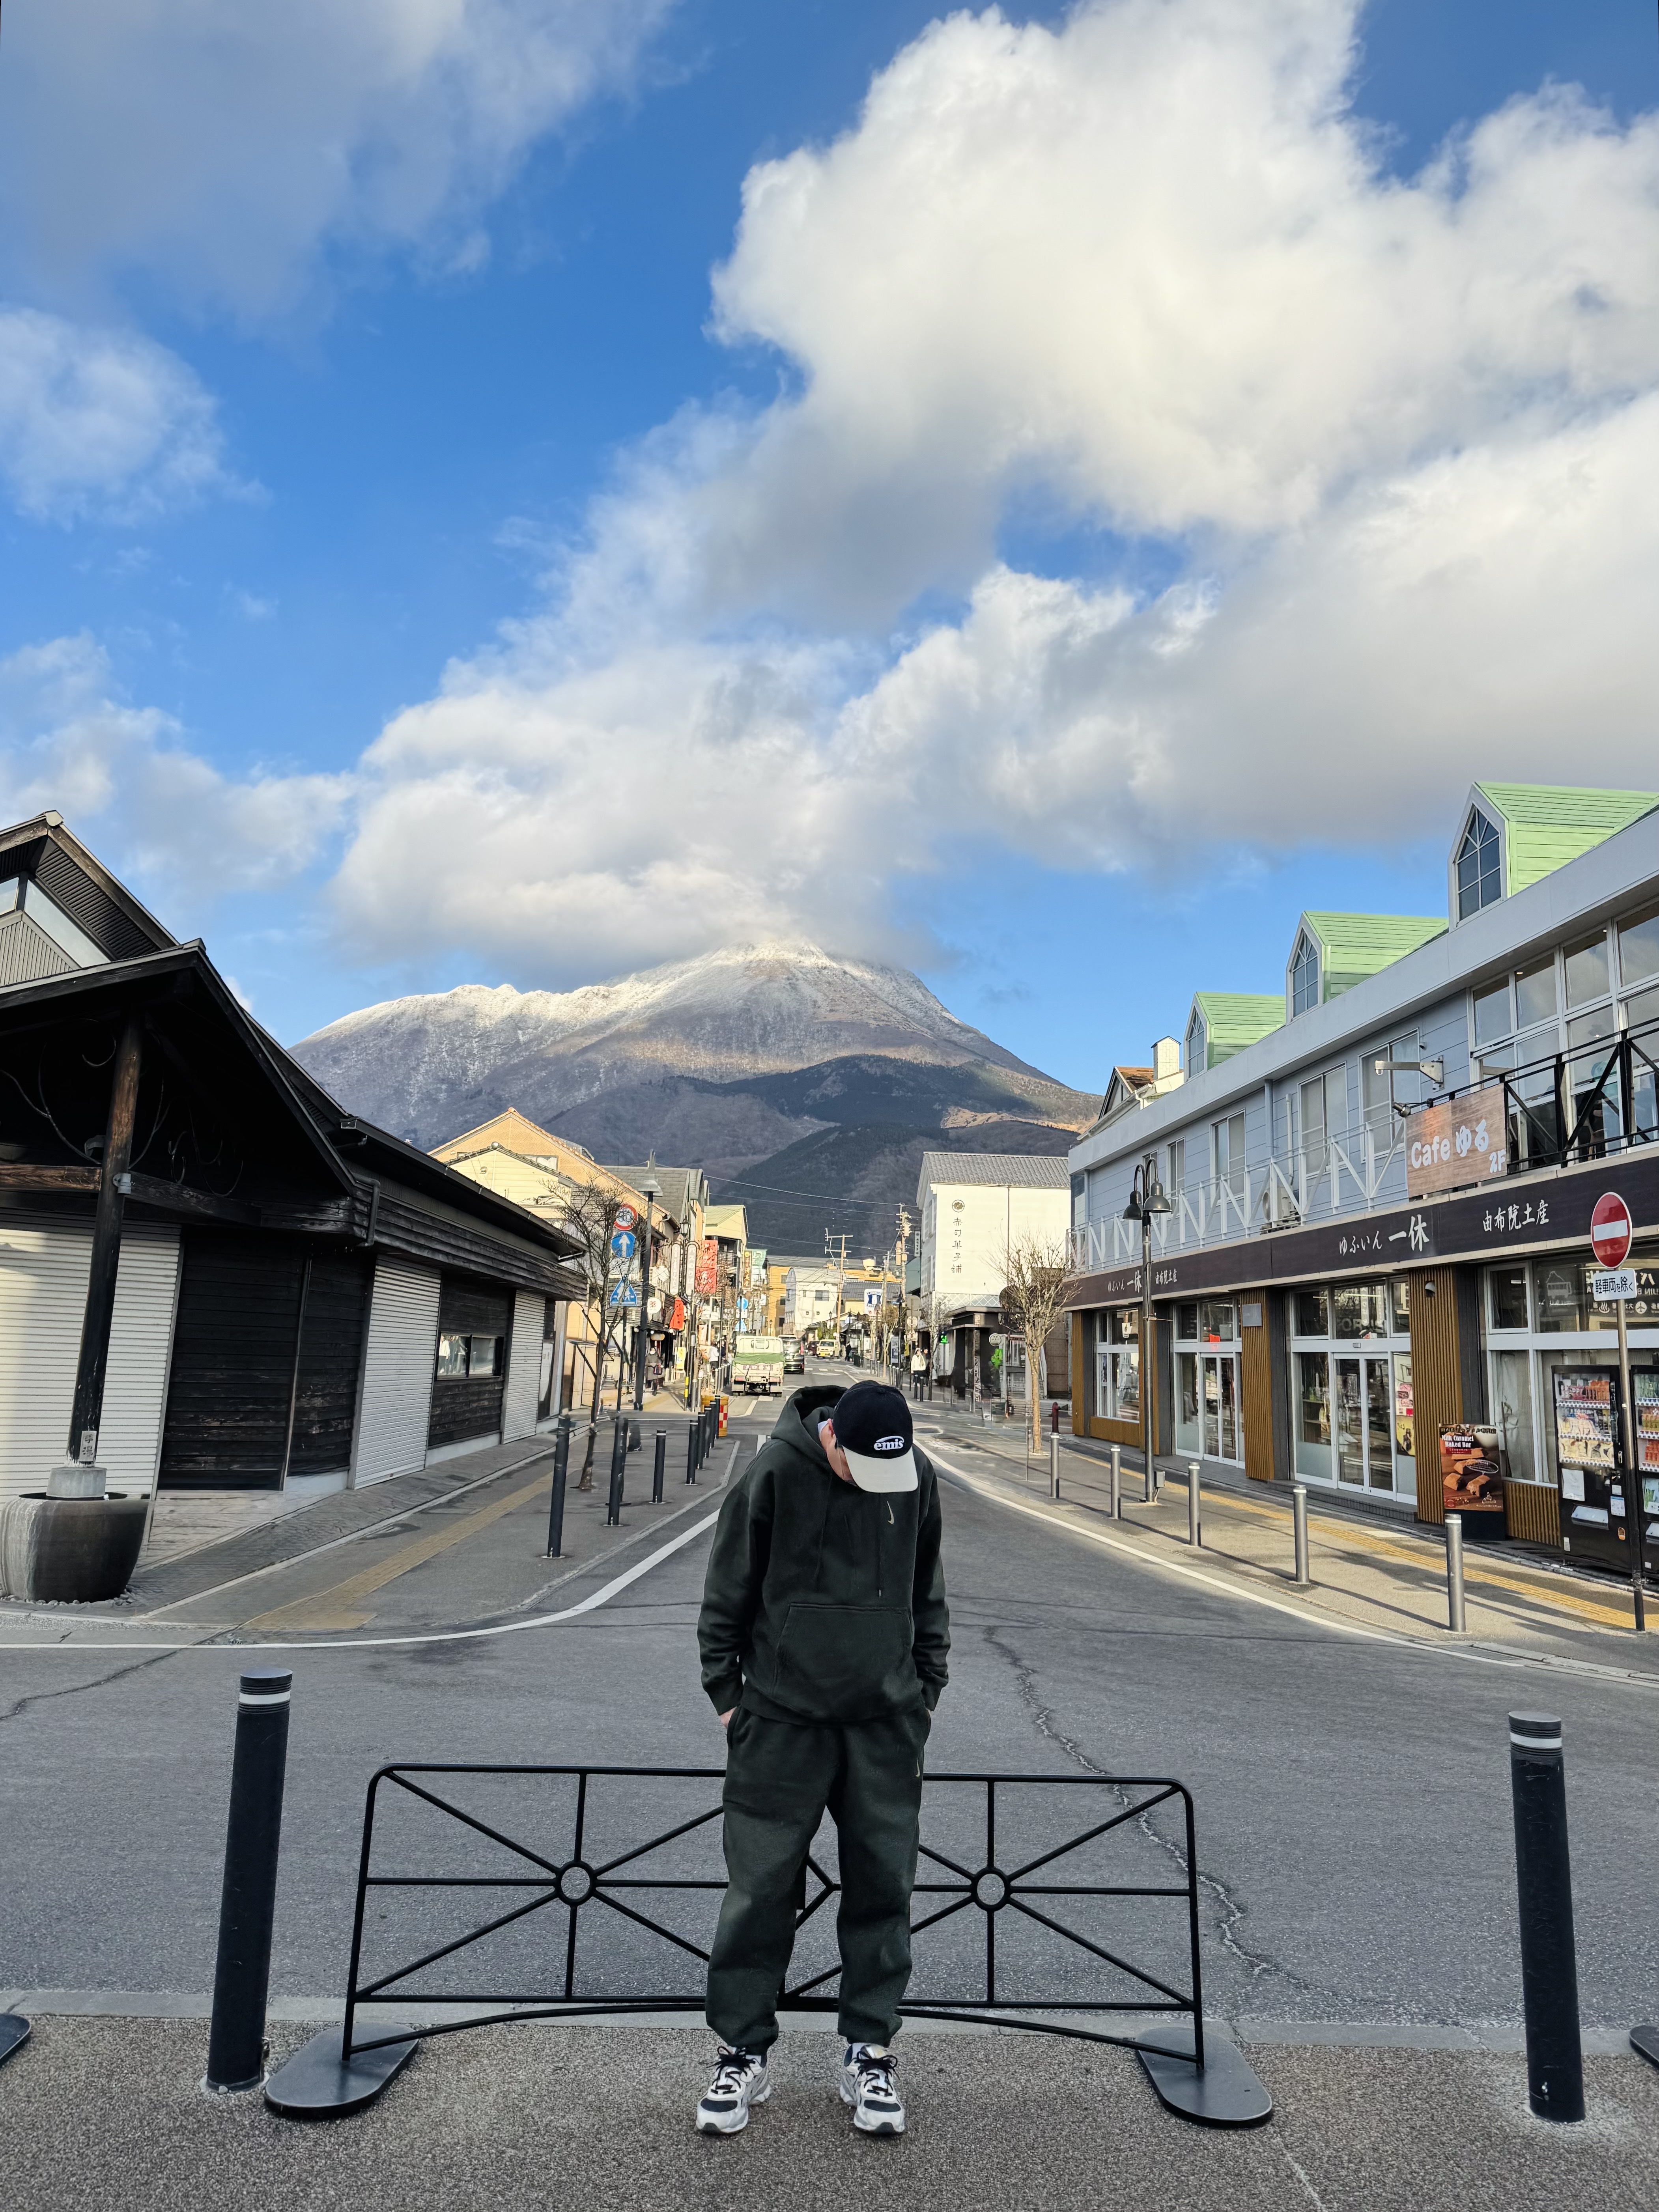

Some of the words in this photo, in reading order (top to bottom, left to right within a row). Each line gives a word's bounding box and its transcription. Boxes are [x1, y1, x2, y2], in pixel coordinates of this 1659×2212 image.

[1411, 1135, 1450, 1169] Cafe
[1456, 1119, 1489, 1157] ゆる
[1489, 1149, 1506, 1173] 2F
[1483, 1199, 1549, 1232] 由布院土産
[1339, 1230, 1382, 1256] ゆふいん
[1388, 1214, 1430, 1252] 一休
[1127, 1270, 1142, 1293] 一休
[1595, 1276, 1633, 1294] 軽車両を除く
[874, 1438, 904, 1450] emis
